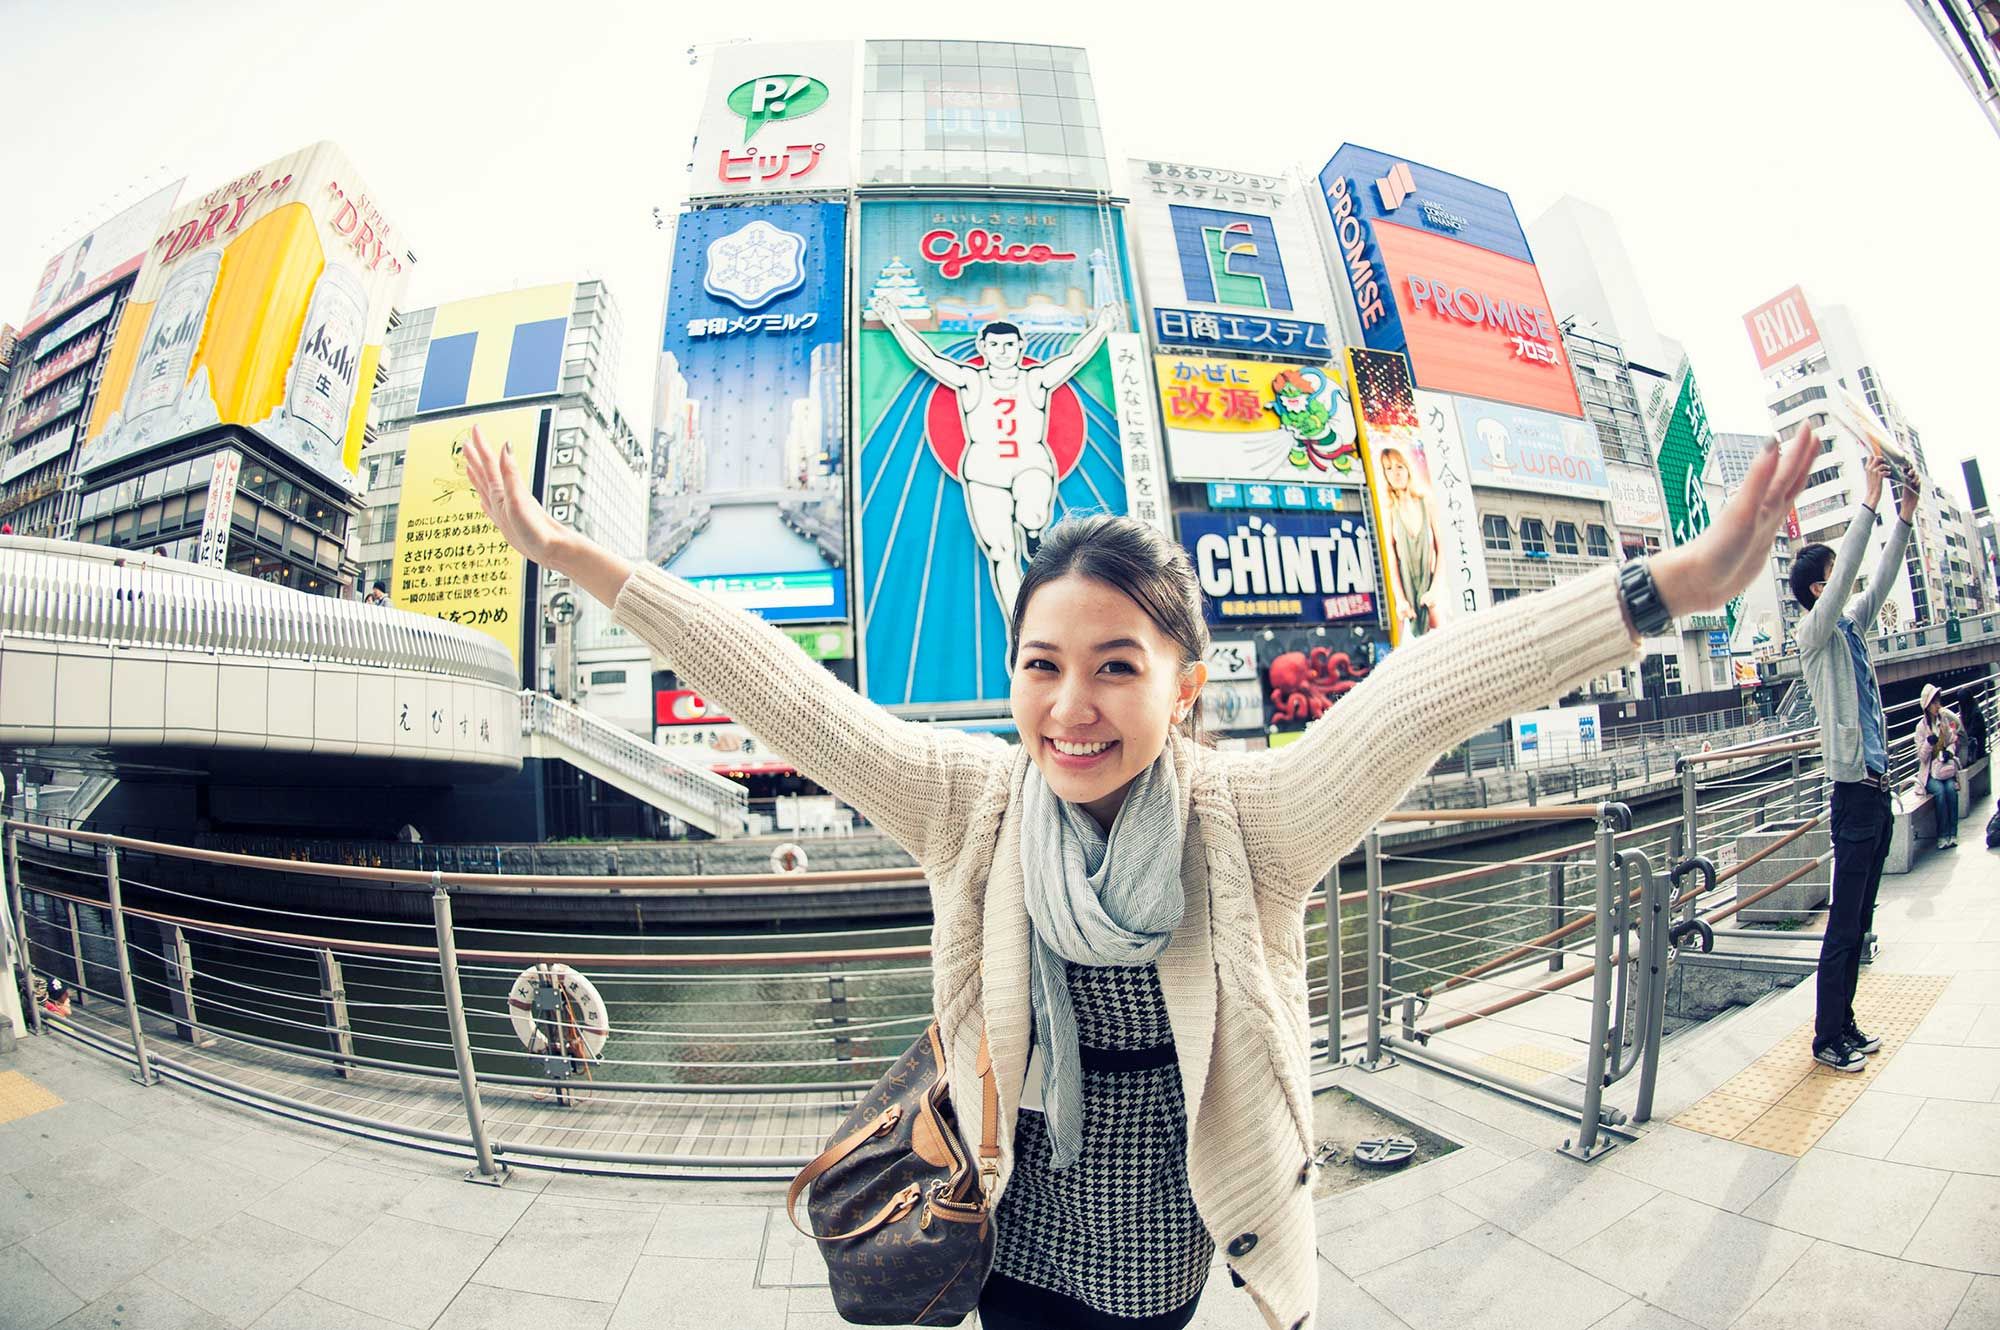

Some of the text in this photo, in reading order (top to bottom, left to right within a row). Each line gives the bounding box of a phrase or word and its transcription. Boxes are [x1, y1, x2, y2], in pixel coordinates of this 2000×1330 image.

[719, 143, 825, 182] ピップ
[199, 170, 262, 210] SUPER
[1151, 181, 1282, 208] エステムコート
[1327, 176, 1386, 330] PROMISE
[686, 312, 818, 337] 雪印メグミルク
[1407, 273, 1553, 343] PROMISE
[1161, 311, 1329, 349] 日商エステム
[305, 323, 355, 386] Asahi
[1511, 335, 1561, 365] プロミス
[316, 373, 332, 398] 生
[1174, 361, 1250, 383] かぜに
[1168, 385, 1264, 421] 改源
[201, 528, 213, 566] かに
[214, 528, 227, 569] かに
[1196, 515, 1375, 597] CHINTAI
